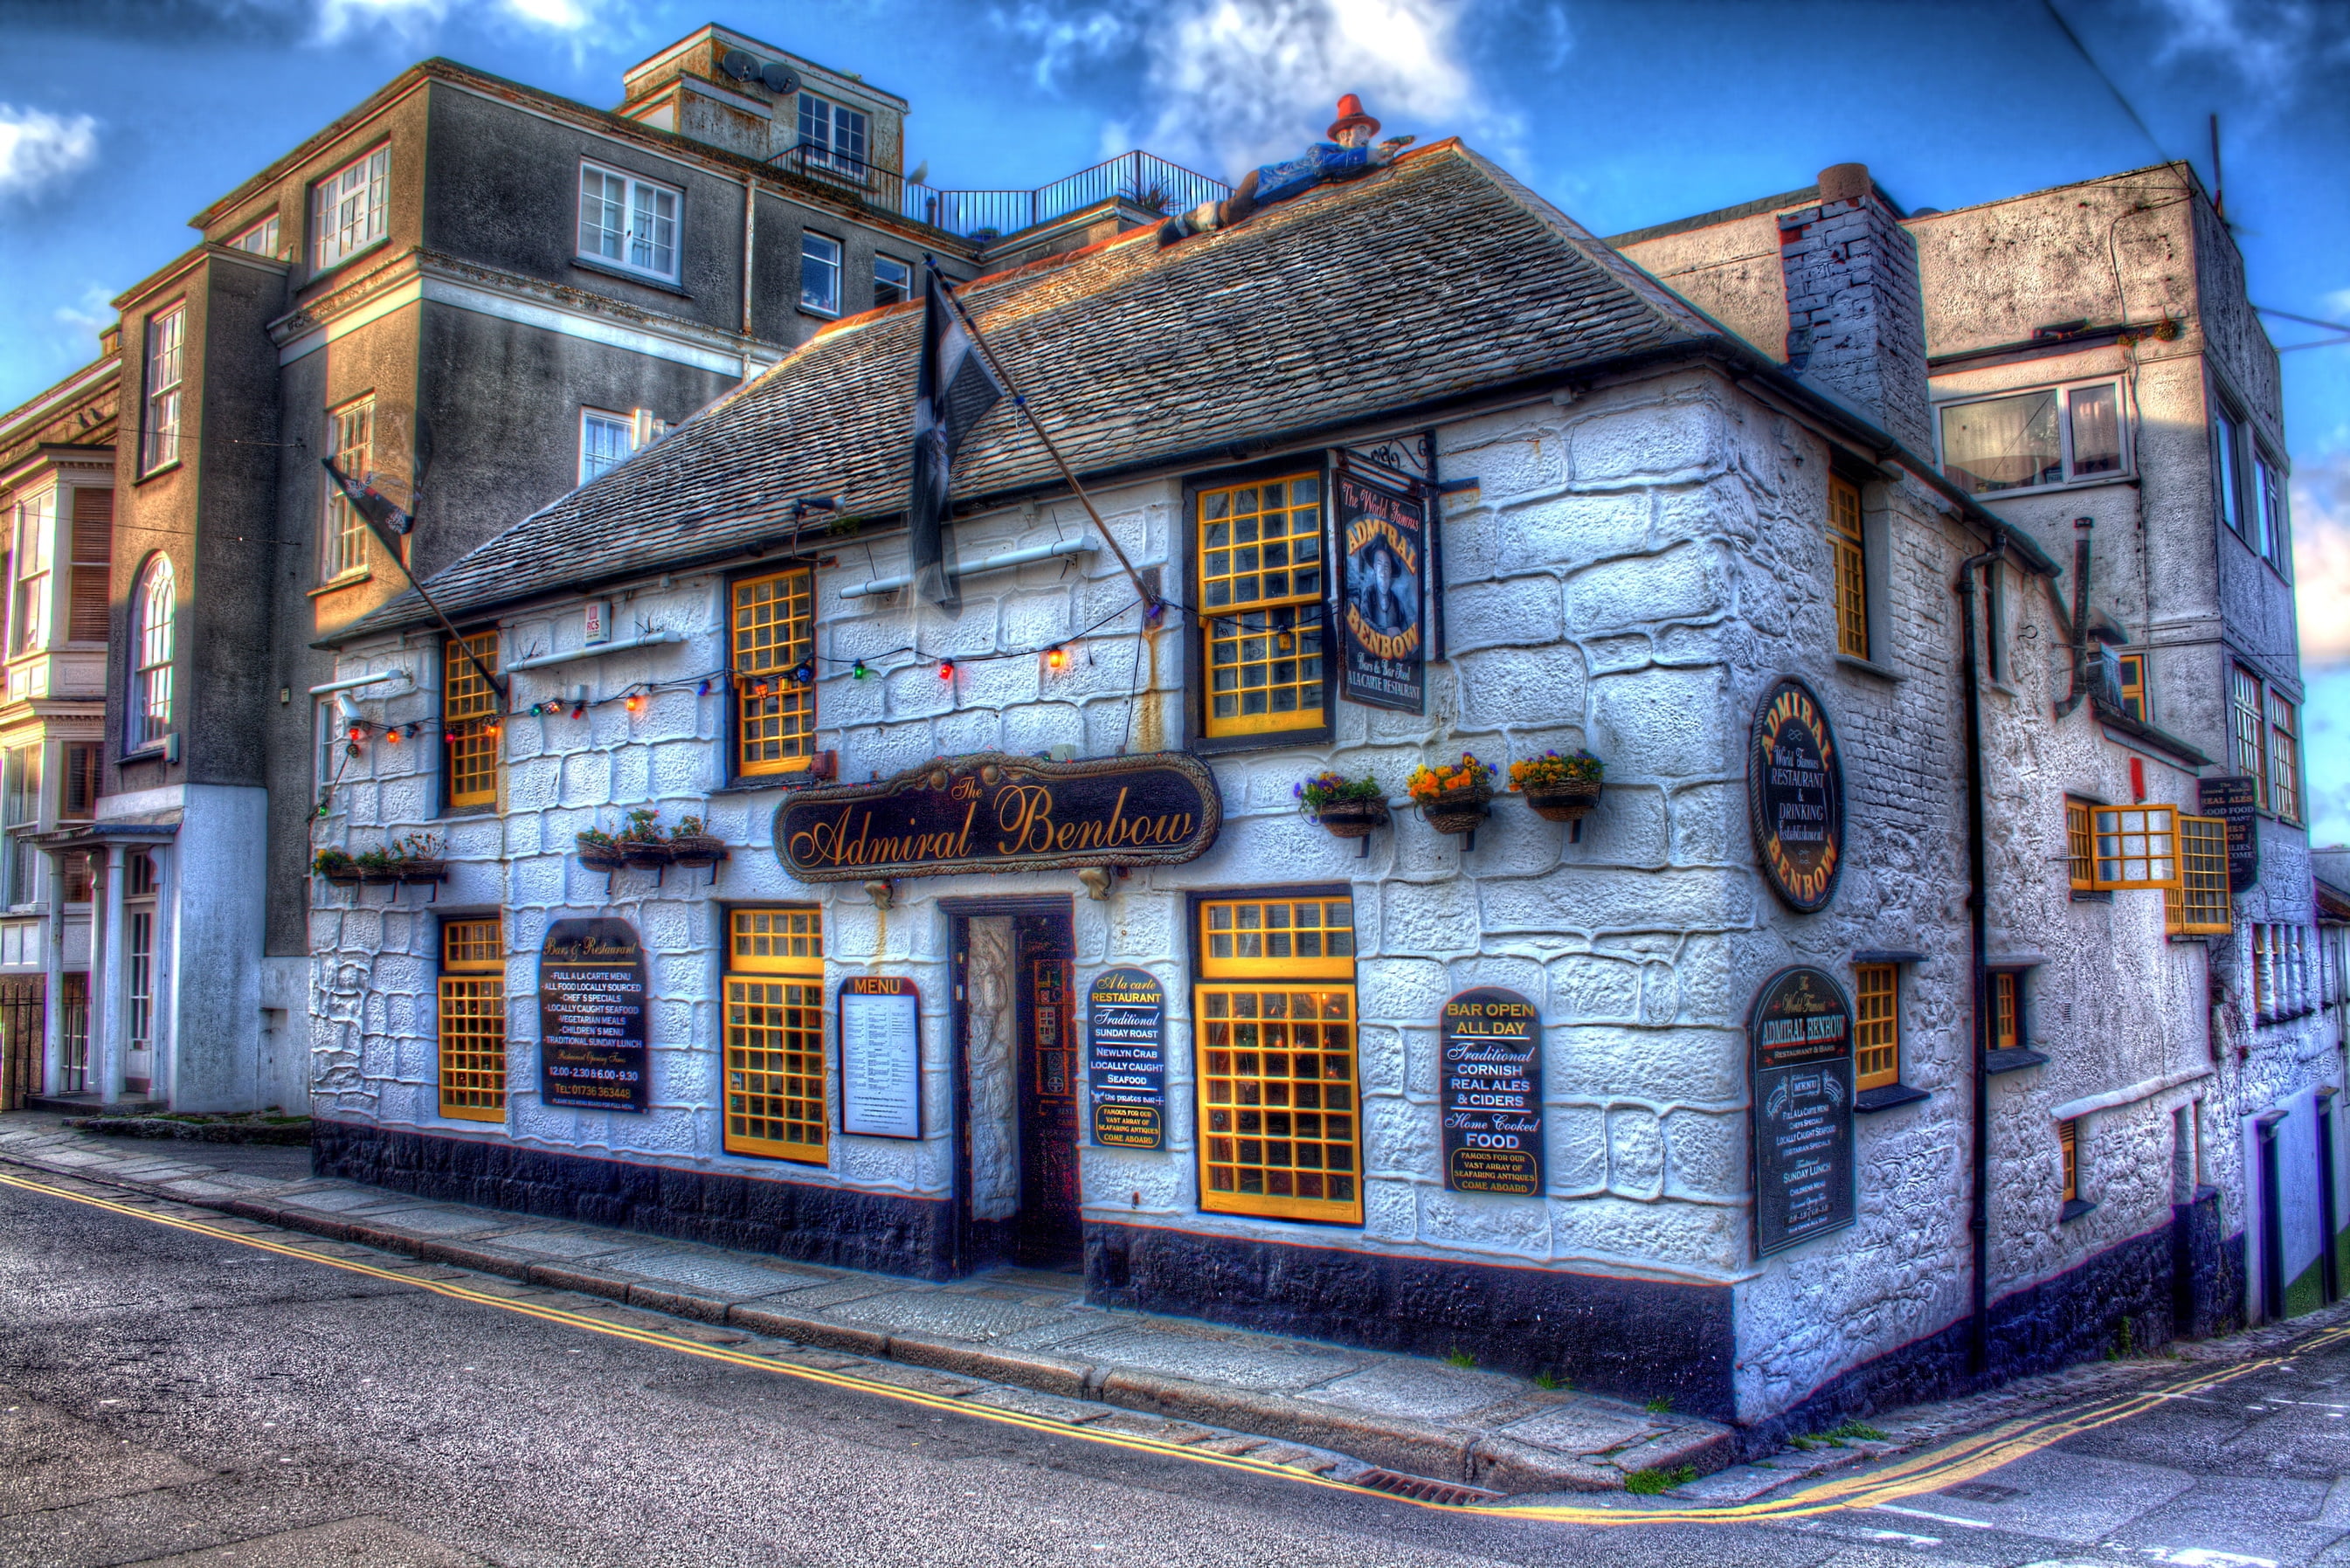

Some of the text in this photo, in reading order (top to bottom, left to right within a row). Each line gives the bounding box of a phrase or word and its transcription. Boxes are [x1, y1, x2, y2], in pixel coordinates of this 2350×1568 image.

[1343, 482, 1419, 531] The World Famous
[1346, 519, 1417, 576] ADMIRAL
[1346, 602, 1420, 660] BENBOW
[1358, 652, 1411, 681] Bars & Bar Food
[1352, 672, 1361, 686] LA
[1361, 673, 1382, 691] CARTE
[1383, 679, 1420, 699] RESTAURANT
[1761, 692, 1832, 771] ADMIRAL
[1774, 745, 1819, 769] World Famous
[1772, 768, 1824, 788] RESTAURANT
[952, 776, 983, 801] The
[1798, 788, 1804, 802] &
[2229, 795, 2253, 804] ALES
[1780, 803, 1823, 820] DRINKING
[2201, 805, 2254, 816] GOOD FOOD
[791, 784, 1194, 867] Admiral Benbow
[1780, 819, 1823, 841] Establishment
[1768, 831, 1837, 902] BENBOW
[543, 936, 637, 962] Bars & Restaurant
[586, 972, 610, 981] CARTE
[1096, 973, 1156, 990] A la carte
[577, 983, 607, 991] LOCALLY
[607, 984, 642, 992] SOURCED
[854, 978, 901, 995] MENU
[588, 994, 622, 1003] SPECIALS
[1091, 992, 1161, 1004] RESTAURANT
[1782, 991, 1803, 1013] World
[577, 1005, 605, 1013] CAUGHT
[605, 1005, 639, 1014] SEAFOOD
[1447, 1003, 1535, 1017] BAR OPEN
[1094, 1008, 1160, 1026] Traditional
[602, 1027, 624, 1036] MENU
[1095, 1028, 1158, 1039] SUNDAY ROAST
[1456, 1021, 1527, 1035] ALL DAY
[1763, 1014, 1846, 1047] ADMIRAL BENBOW
[589, 1038, 617, 1047] SUNDAY
[616, 1040, 642, 1048] LUNCH
[1096, 1047, 1158, 1059] NEWLYN CRAB
[1447, 1042, 1536, 1062] Traditional
[1774, 1048, 1813, 1059] RESTAURANT
[1819, 1044, 1835, 1053] BARS
[549, 1066, 639, 1081] 12.00 2.30 & 6.00 9.30
[1090, 1060, 1165, 1073] LOCALLY CAUGHT
[1457, 1063, 1524, 1076] CORNISH
[1107, 1074, 1147, 1085] SEAFOOD
[1450, 1078, 1531, 1092] REAL ALES
[1794, 1080, 1817, 1092] MENU
[572, 1084, 597, 1097] 01736
[598, 1086, 632, 1099] 363448
[1457, 1093, 1524, 1107] & CIDERS
[1103, 1108, 1127, 1116] FAMOUS
[1444, 1112, 1541, 1133] Home Cooked
[1803, 1116, 1824, 1127] SPECIALS
[1098, 1124, 1159, 1135] SEAFARING ANTIQUES
[1776, 1124, 1836, 1146] LOCALLY CAUGHT SEAFOOD
[1103, 1133, 1153, 1144] COME ABOARD
[1466, 1132, 1520, 1149] FOOD
[1808, 1139, 1831, 1150] SPECIALS
[1461, 1152, 1492, 1161] FAMOUS
[1509, 1154, 1526, 1163] OUR
[1463, 1161, 1523, 1172] VAST ARRAY OF
[1783, 1161, 1831, 1185] SUNDAY LUNCH
[1454, 1170, 1535, 1182] SEAFARING ANTIQUES
[1462, 1180, 1528, 1192] COME ABOARD
